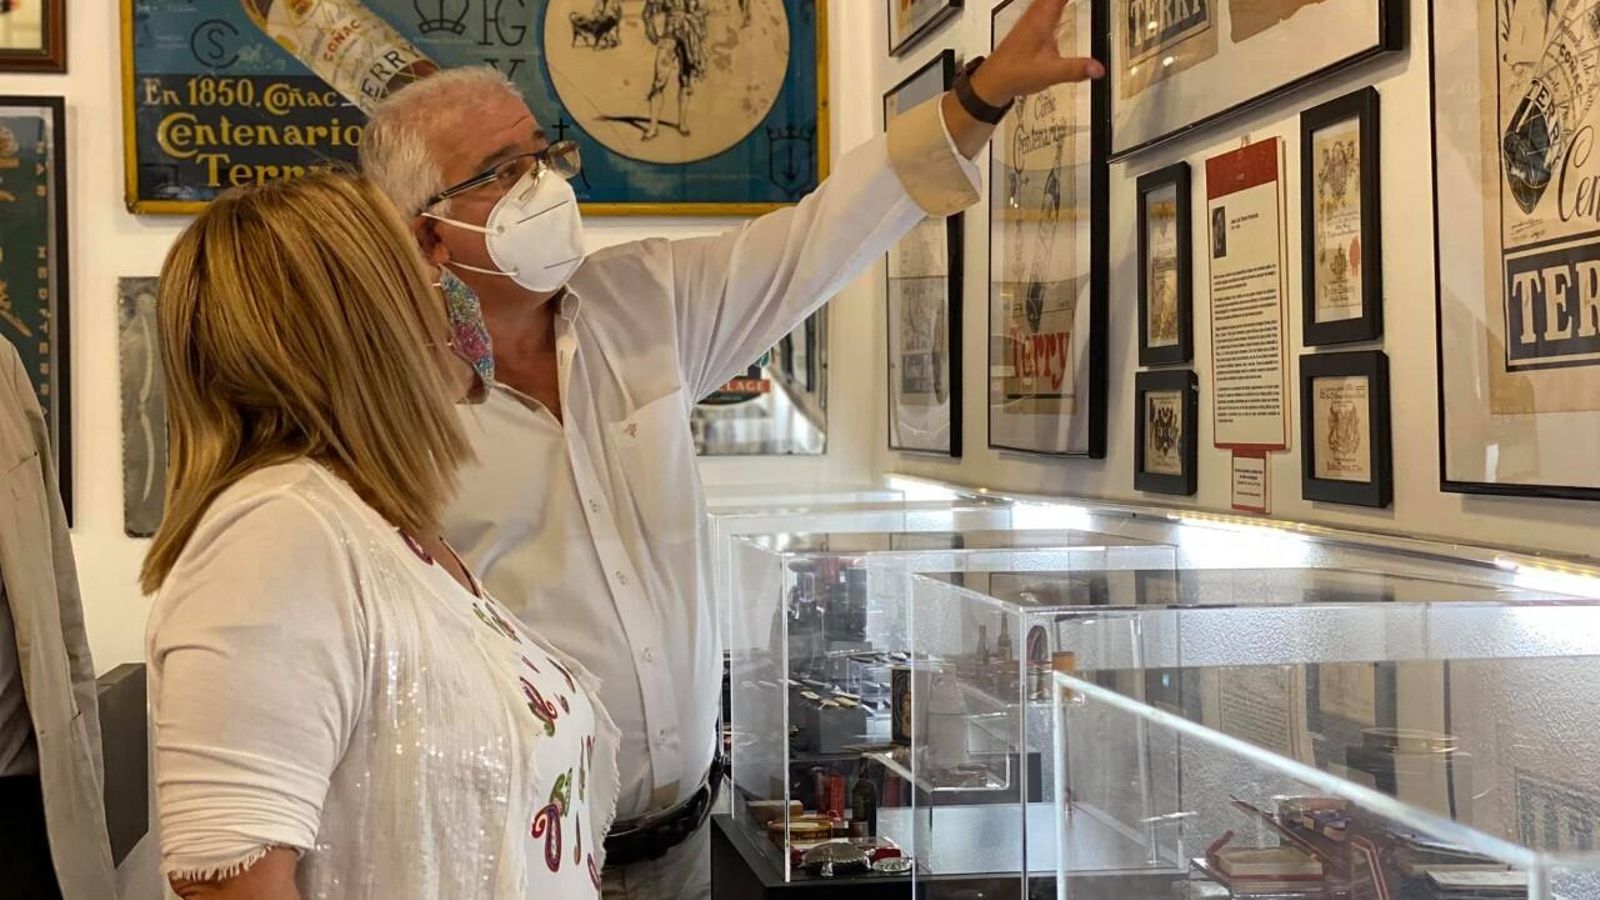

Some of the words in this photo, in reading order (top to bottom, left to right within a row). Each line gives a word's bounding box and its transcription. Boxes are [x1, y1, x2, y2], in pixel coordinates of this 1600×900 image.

[143, 77, 181, 107] En
[263, 83, 338, 115] Coñac
[156, 111, 366, 159] Centenario
